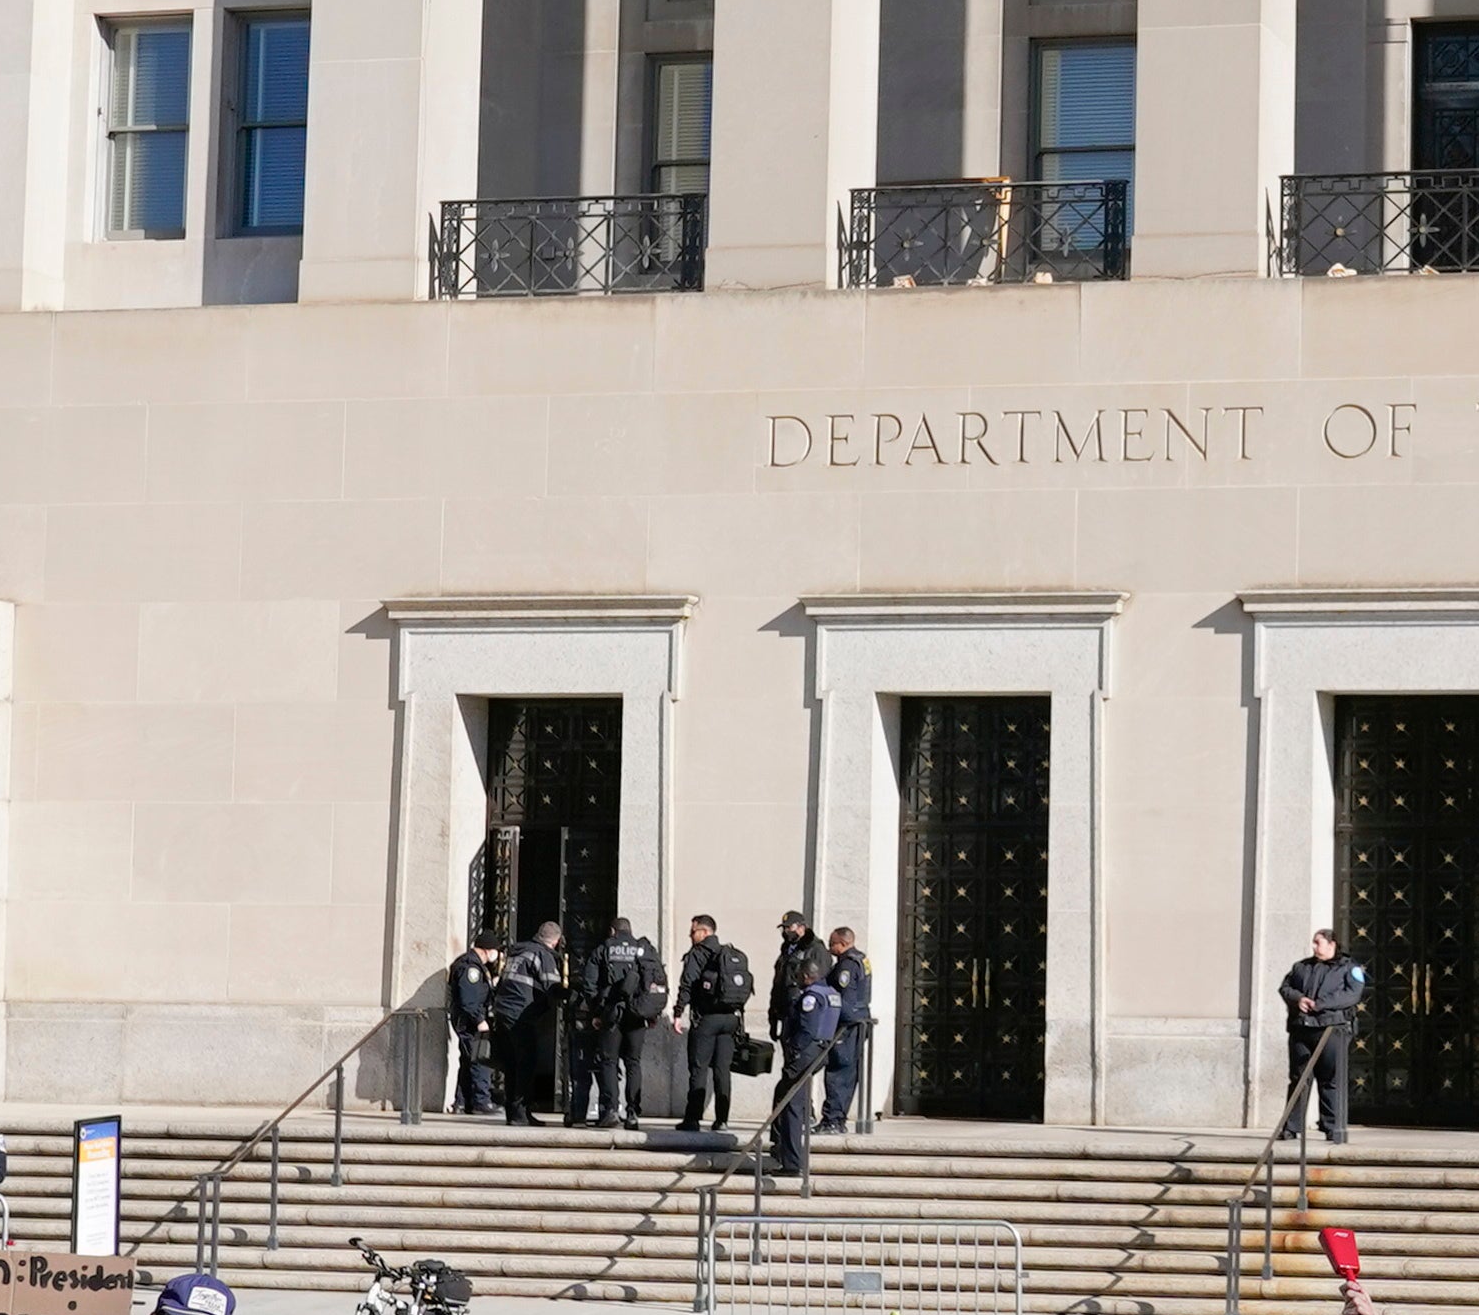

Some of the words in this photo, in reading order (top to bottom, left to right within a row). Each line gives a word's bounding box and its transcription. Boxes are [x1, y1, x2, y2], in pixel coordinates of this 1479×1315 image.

[766, 404, 1264, 468] DEPARTMENT
[1322, 403, 1417, 460] OF
[29, 1255, 134, 1292] President
